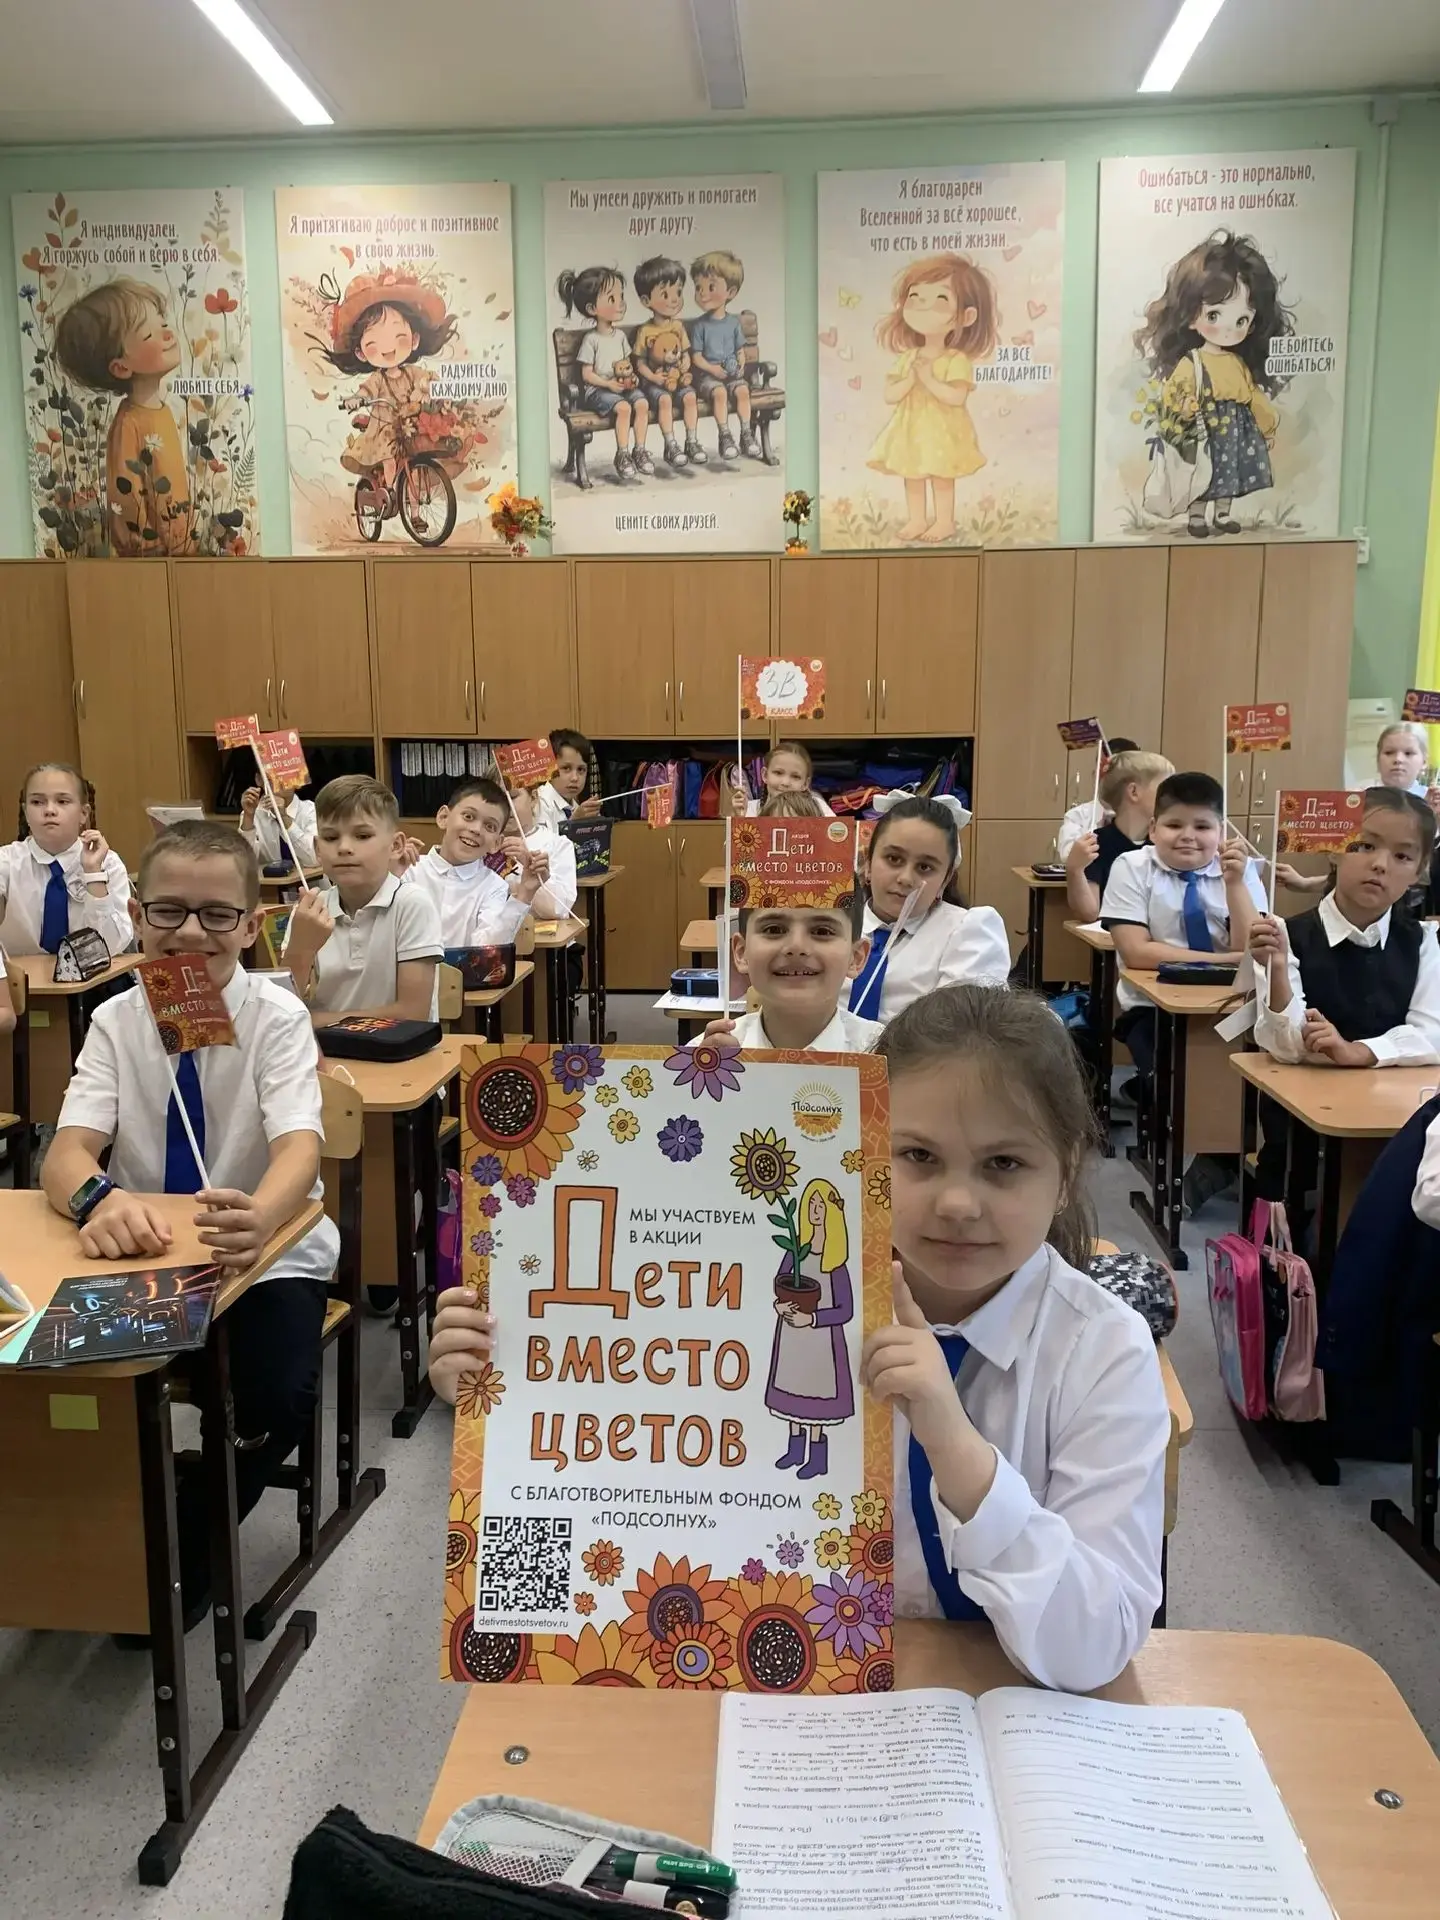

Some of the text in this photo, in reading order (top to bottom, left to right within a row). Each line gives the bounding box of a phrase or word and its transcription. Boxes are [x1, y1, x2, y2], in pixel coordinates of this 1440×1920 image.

[1139, 167, 1208, 188] Ошибаться
[1220, 168, 1239, 184] это
[1242, 165, 1316, 186] нормально,
[898, 178, 982, 200] Я благодарен
[570, 188, 757, 211] Мы умеем дружить и помогаем
[1154, 188, 1299, 217] все учатся на ошибках.
[860, 208, 922, 227] Вселенной
[926, 209, 940, 224] за
[966, 205, 1022, 226] хорошее,
[81, 220, 87, 237] Я
[290, 215, 499, 237] Я притягиваю доброе и позитивное
[629, 216, 656, 236] друг
[870, 237, 889, 252] что
[893, 237, 918, 252] есть
[922, 236, 929, 250] в
[932, 231, 962, 250] моей
[43, 243, 221, 268] Я горжусь собой и верю в себя.
[355, 245, 361, 258] в
[365, 244, 393, 258] свою
[997, 347, 1031, 362] ЗА ВСЕ
[1272, 337, 1334, 354] НЕ БОЙТЕСЬ
[441, 363, 497, 379] РАДУЙТЕСЬ
[975, 366, 1052, 382] БЛАГОДАРИТЕ!
[1267, 357, 1336, 374] ОШИБАТЬСЯ!
[173, 379, 212, 394] ЛЮБИТЕ
[431, 382, 507, 399] КАЖДОМУ ДНЮ
[615, 513, 720, 532] ЦЕНИТЕ СВОИХ ДРУЗЕЙ.
[767, 827, 815, 858] Дети
[791, 1100, 842, 1117] Подсолнух
[629, 1208, 756, 1225] МЫ УЧАСТВУЕМ
[629, 1230, 701, 1247] В АКЦИИ
[528, 1185, 742, 1319] Дети
[511, 1486, 801, 1510] С БЛАГОТВОРИТЕЛЬНЫМ ФОНДОМ
[591, 1512, 717, 1530] «ПОДСОЛНУХ»
